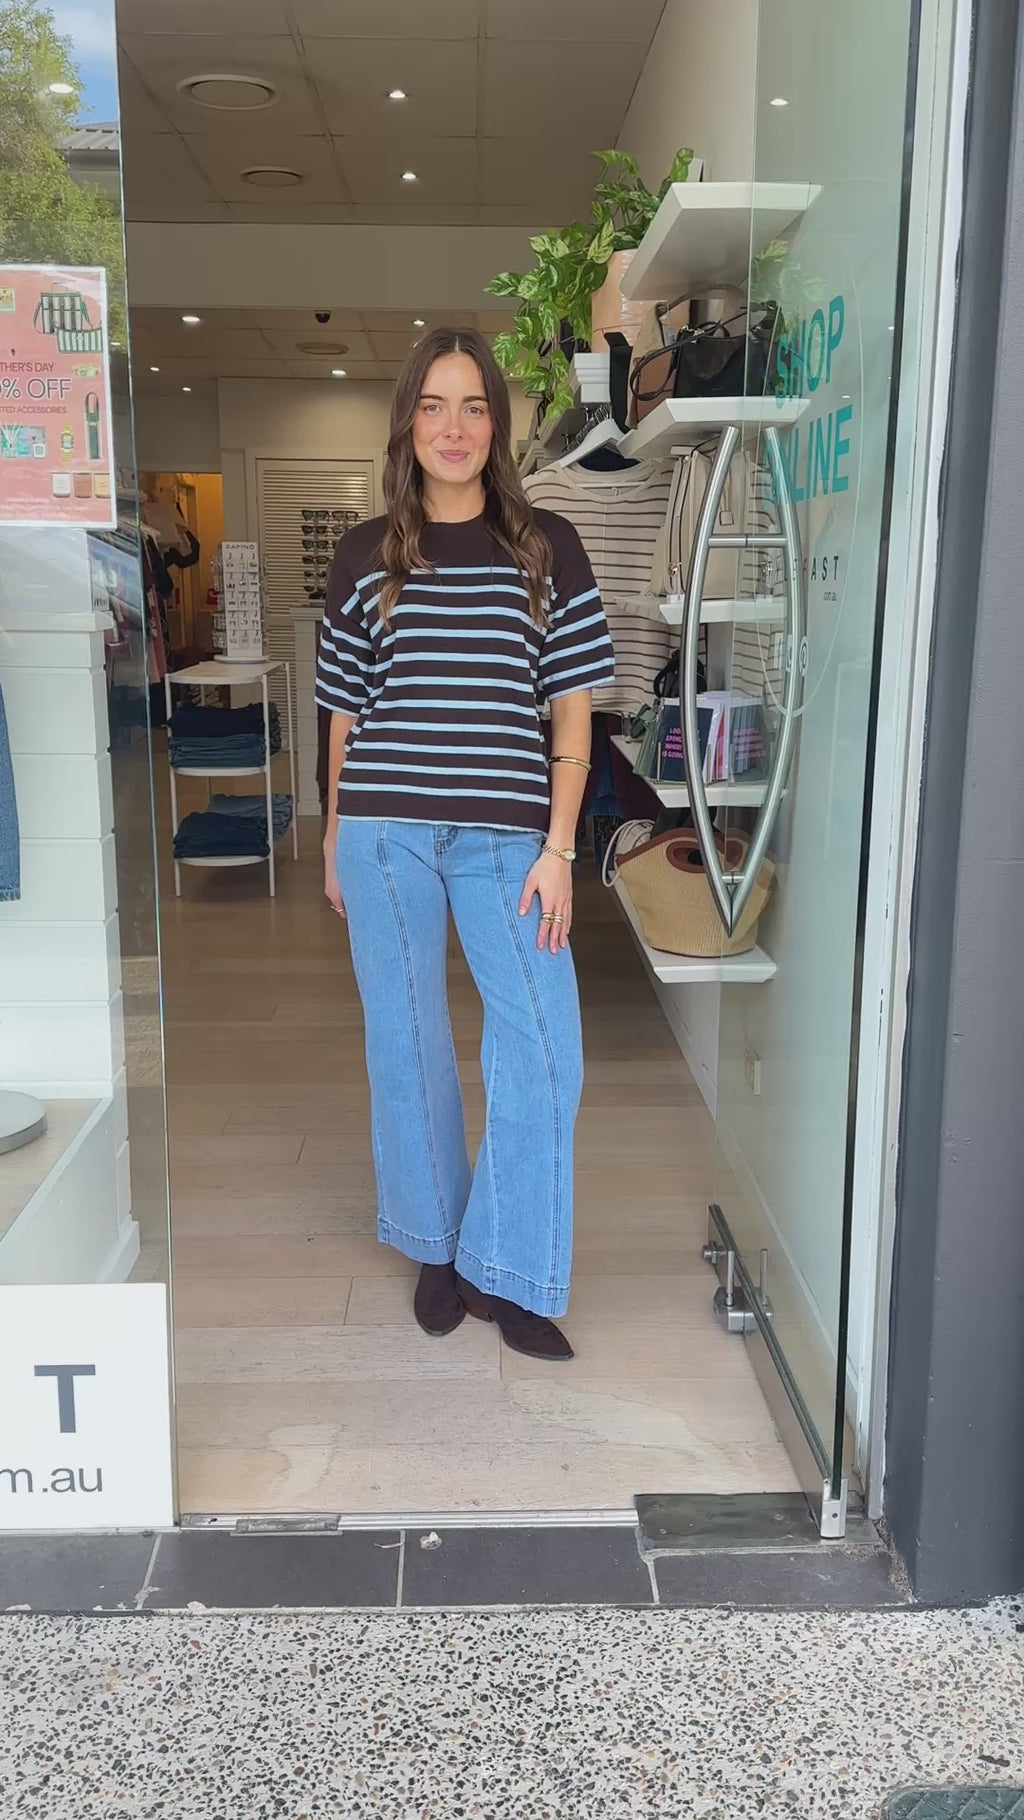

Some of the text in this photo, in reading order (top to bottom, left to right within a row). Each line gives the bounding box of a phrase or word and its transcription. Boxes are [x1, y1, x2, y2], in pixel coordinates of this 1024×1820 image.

[774, 295, 845, 409] SHOP
[35, 362, 54, 372] DAY
[27, 378, 72, 399] OFF
[16, 406, 68, 414] ACCESSORIES
[34, 1364, 96, 1433] T
